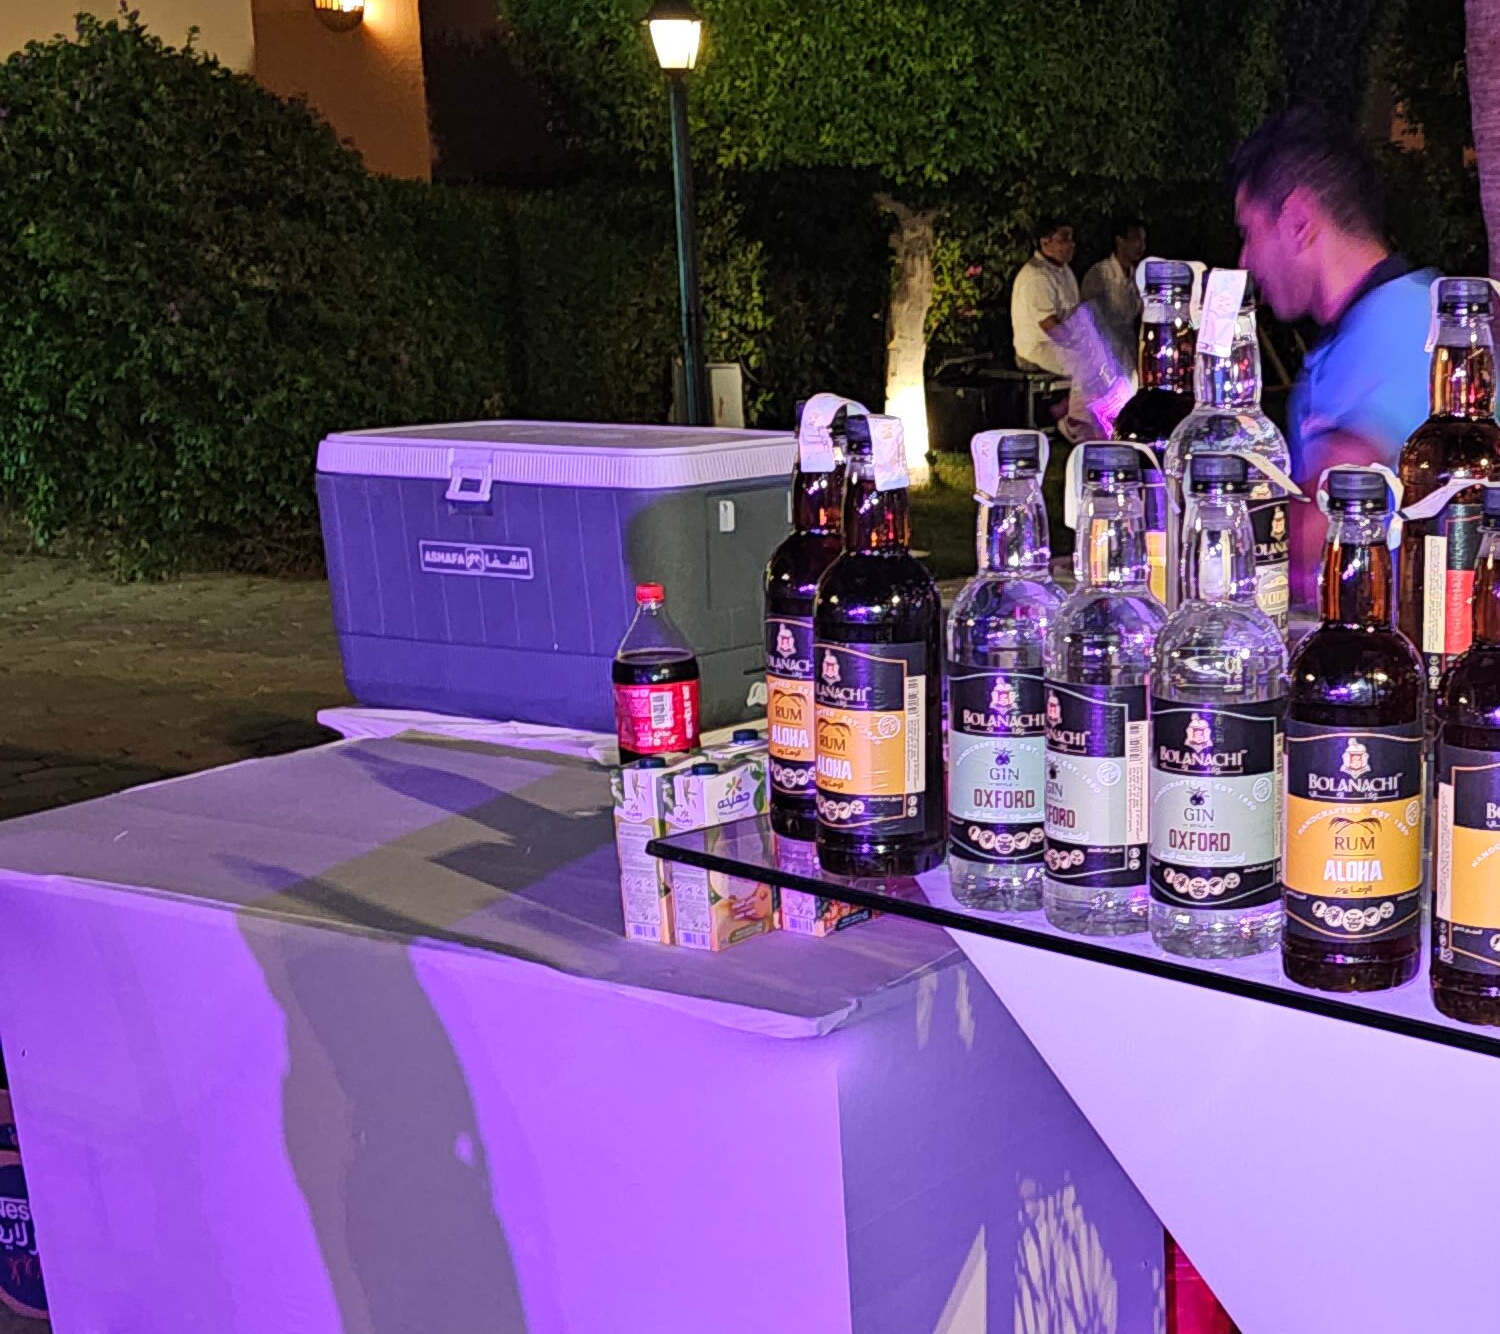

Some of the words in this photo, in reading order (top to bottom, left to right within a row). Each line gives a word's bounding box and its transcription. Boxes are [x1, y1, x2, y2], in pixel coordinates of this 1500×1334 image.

[817, 685, 868, 702] LANACHI
[774, 705, 801, 721] RUM
[963, 709, 1045, 728] BOLANACHI
[771, 724, 809, 748] ALOHA
[819, 735, 846, 751] RUM
[1160, 746, 1244, 766] BOLANACHI
[817, 755, 852, 780] ALOHA
[989, 767, 1020, 781] GIN
[1308, 773, 1399, 792] BOLANACHI
[974, 789, 1036, 809] OXFORD
[1047, 805, 1076, 829] FORD
[1184, 808, 1214, 822] GIN
[1169, 829, 1231, 852] OXFORD
[1334, 836, 1375, 851] RUM
[1323, 859, 1383, 882] ALOHA
